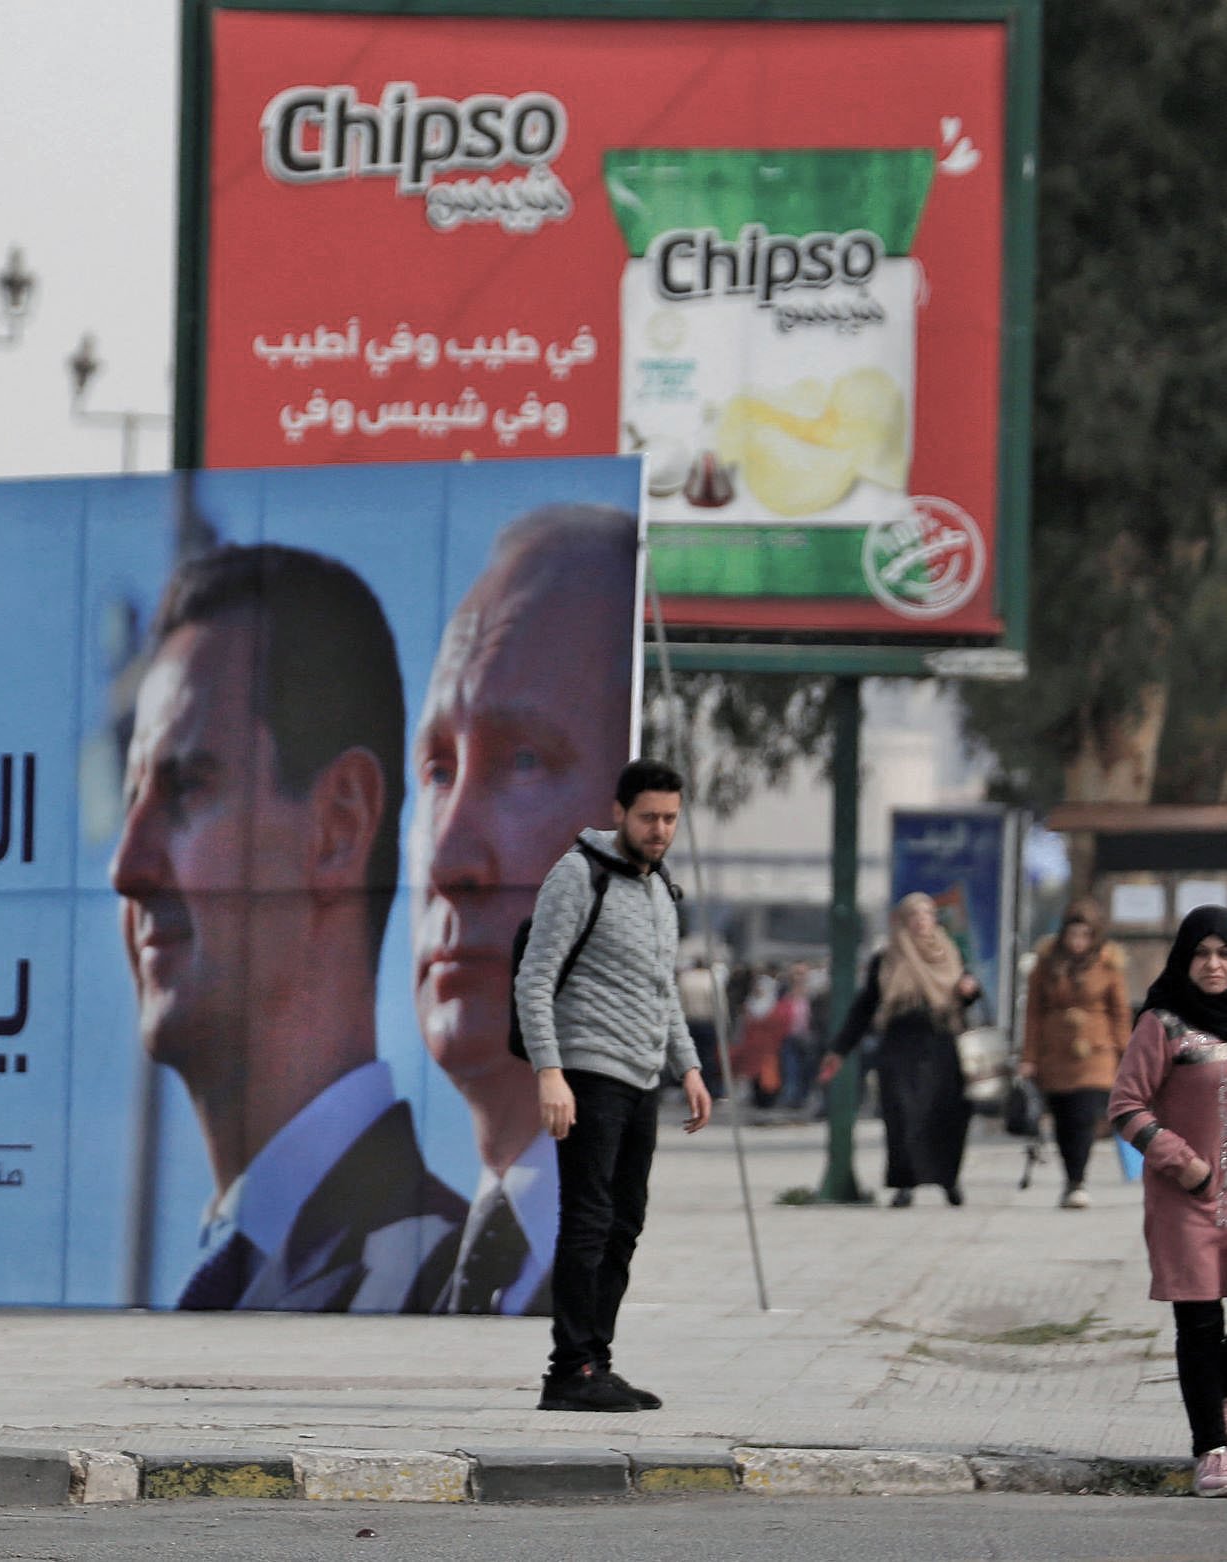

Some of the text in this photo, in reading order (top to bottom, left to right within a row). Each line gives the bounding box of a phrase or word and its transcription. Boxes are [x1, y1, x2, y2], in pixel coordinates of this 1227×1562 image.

[266, 84, 565, 193] Chipso
[653, 224, 880, 305] Chipso
[252, 316, 360, 368] أطيب
[365, 322, 440, 376] وفي
[444, 327, 540, 369] طيب
[544, 324, 598, 379] في
[279, 386, 568, 446] وفي شيبس وفي
